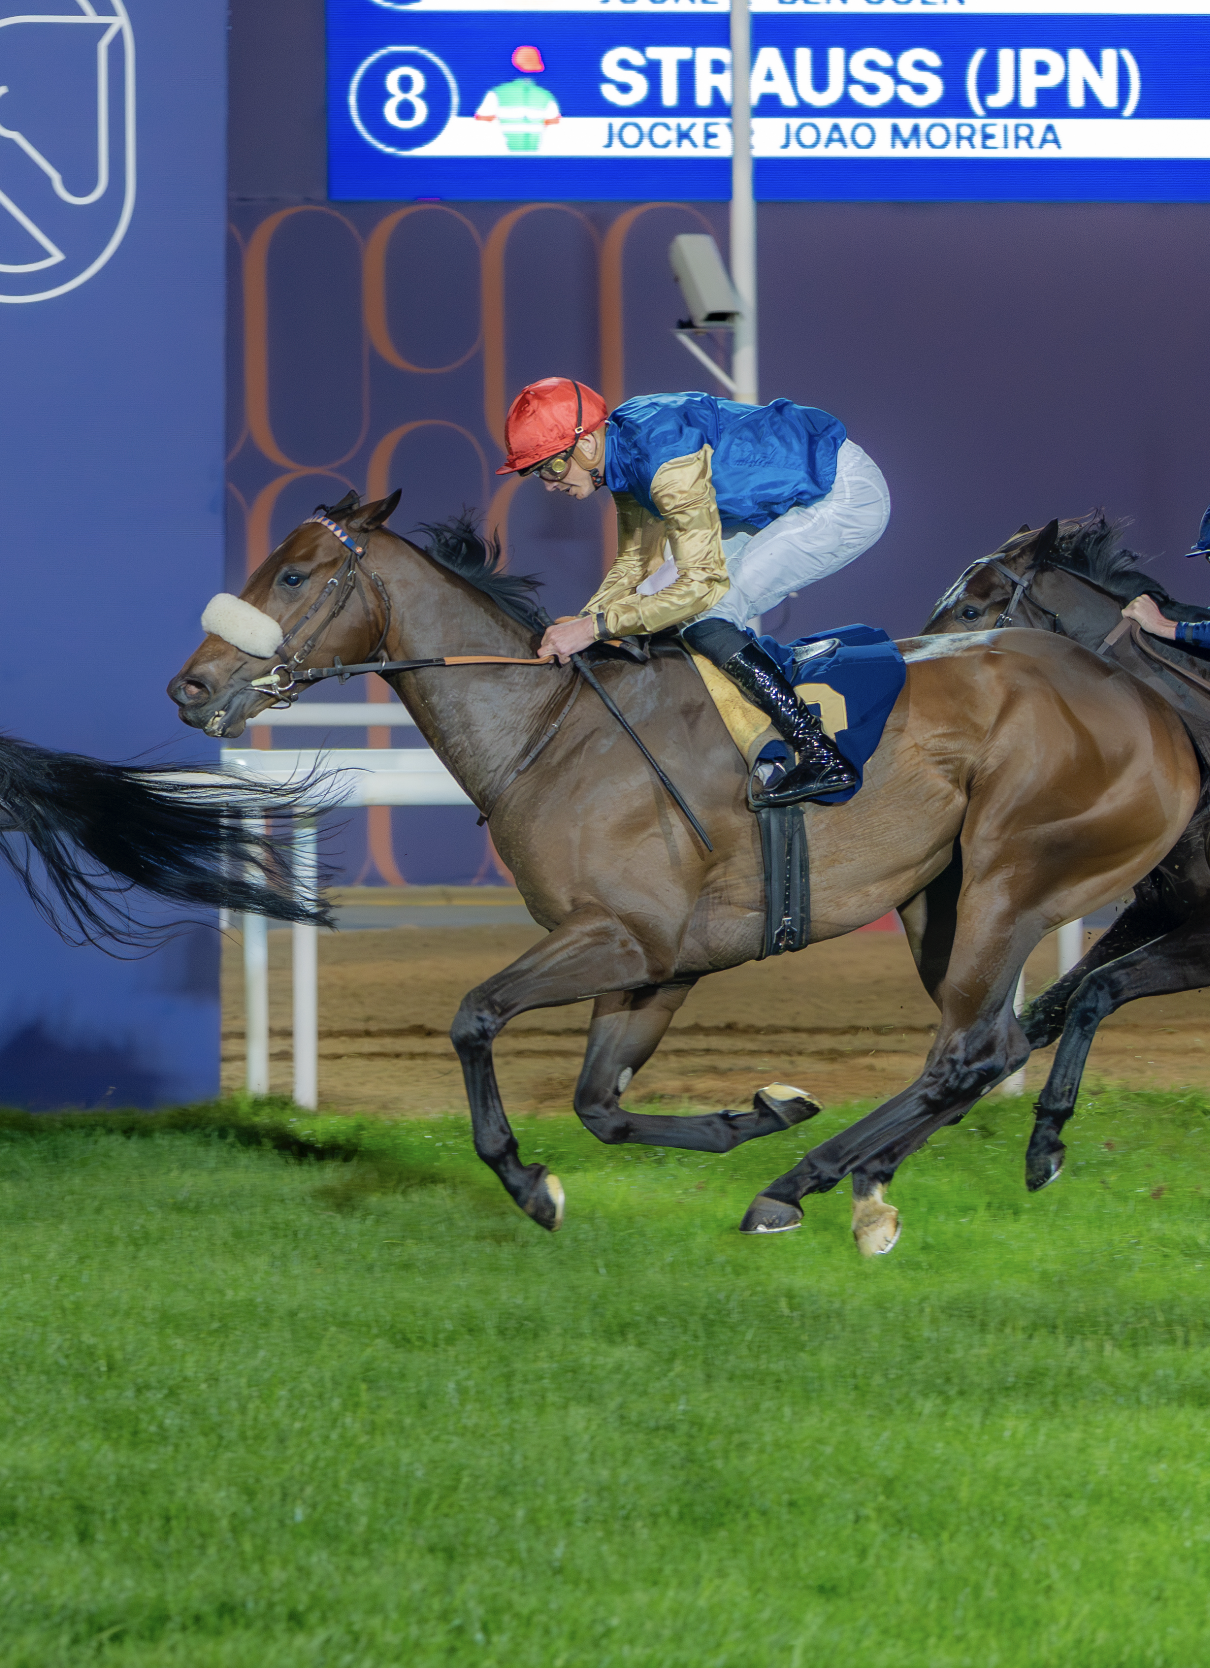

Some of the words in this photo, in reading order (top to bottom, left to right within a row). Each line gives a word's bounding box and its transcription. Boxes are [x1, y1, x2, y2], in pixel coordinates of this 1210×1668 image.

[383, 66, 429, 129] 8
[600, 46, 945, 108] STRAUSS
[966, 47, 1141, 118] (JPN)
[779, 122, 877, 150] JOAO
[889, 122, 1062, 150] MOREIRA
